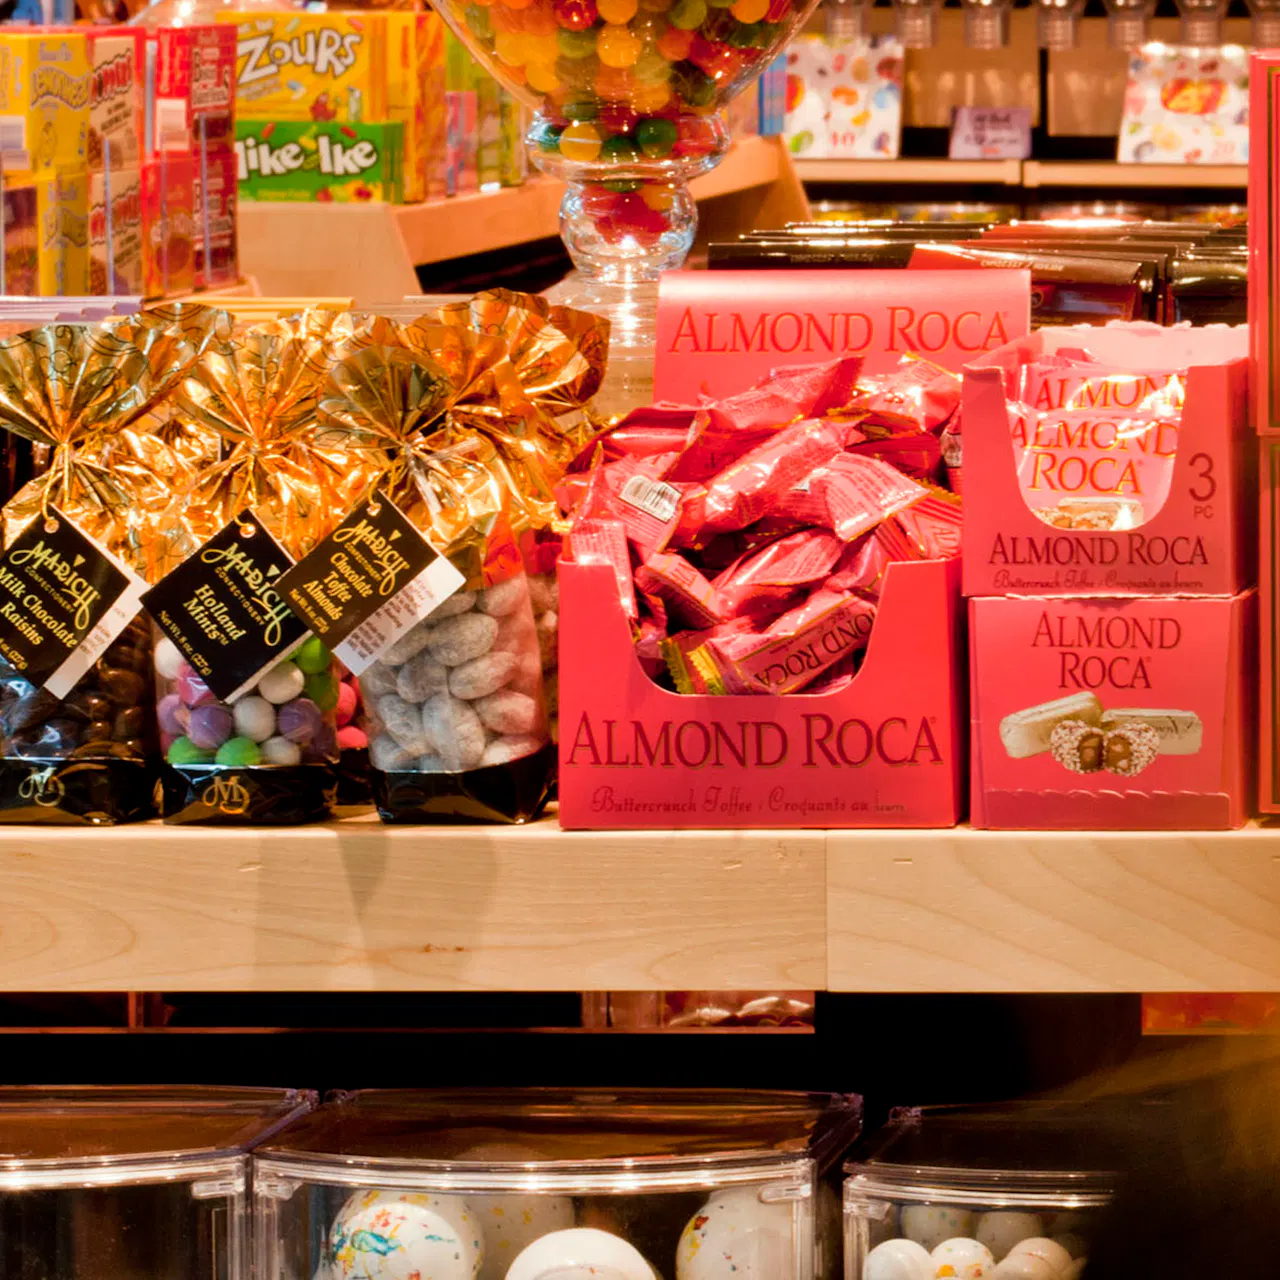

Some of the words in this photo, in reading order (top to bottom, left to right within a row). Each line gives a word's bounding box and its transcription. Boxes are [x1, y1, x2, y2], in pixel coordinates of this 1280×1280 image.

[319, 135, 379, 177] Ike
[668, 305, 874, 354] ALMOND
[885, 304, 1008, 353] ROCA
[1012, 416, 1180, 459] ALMOND
[1028, 452, 1143, 495] ROCA
[1188, 452, 1217, 502] 3
[1194, 505, 1214, 519] PC
[334, 519, 411, 596] MARICH
[988, 532, 1119, 566] ALMOND
[1127, 532, 1209, 566] ROCA
[10, 540, 90, 630] MARICH
[202, 542, 295, 646] MARICH
[320, 570, 354, 606] Toffee
[328, 550, 375, 601] Chocolate
[20, 591, 81, 650] Chocolate
[193, 583, 247, 643] Holland
[302, 577, 345, 623] Almonds
[1031, 609, 1183, 650] ALMOND
[754, 640, 825, 690] ROCA
[1058, 651, 1153, 690] ROCA
[565, 709, 790, 768] ALMOND
[800, 711, 944, 768] ROCA
[592, 786, 698, 813] Buttercrunch
[703, 786, 752, 816] Toffee
[768, 786, 847, 815] Croquants
